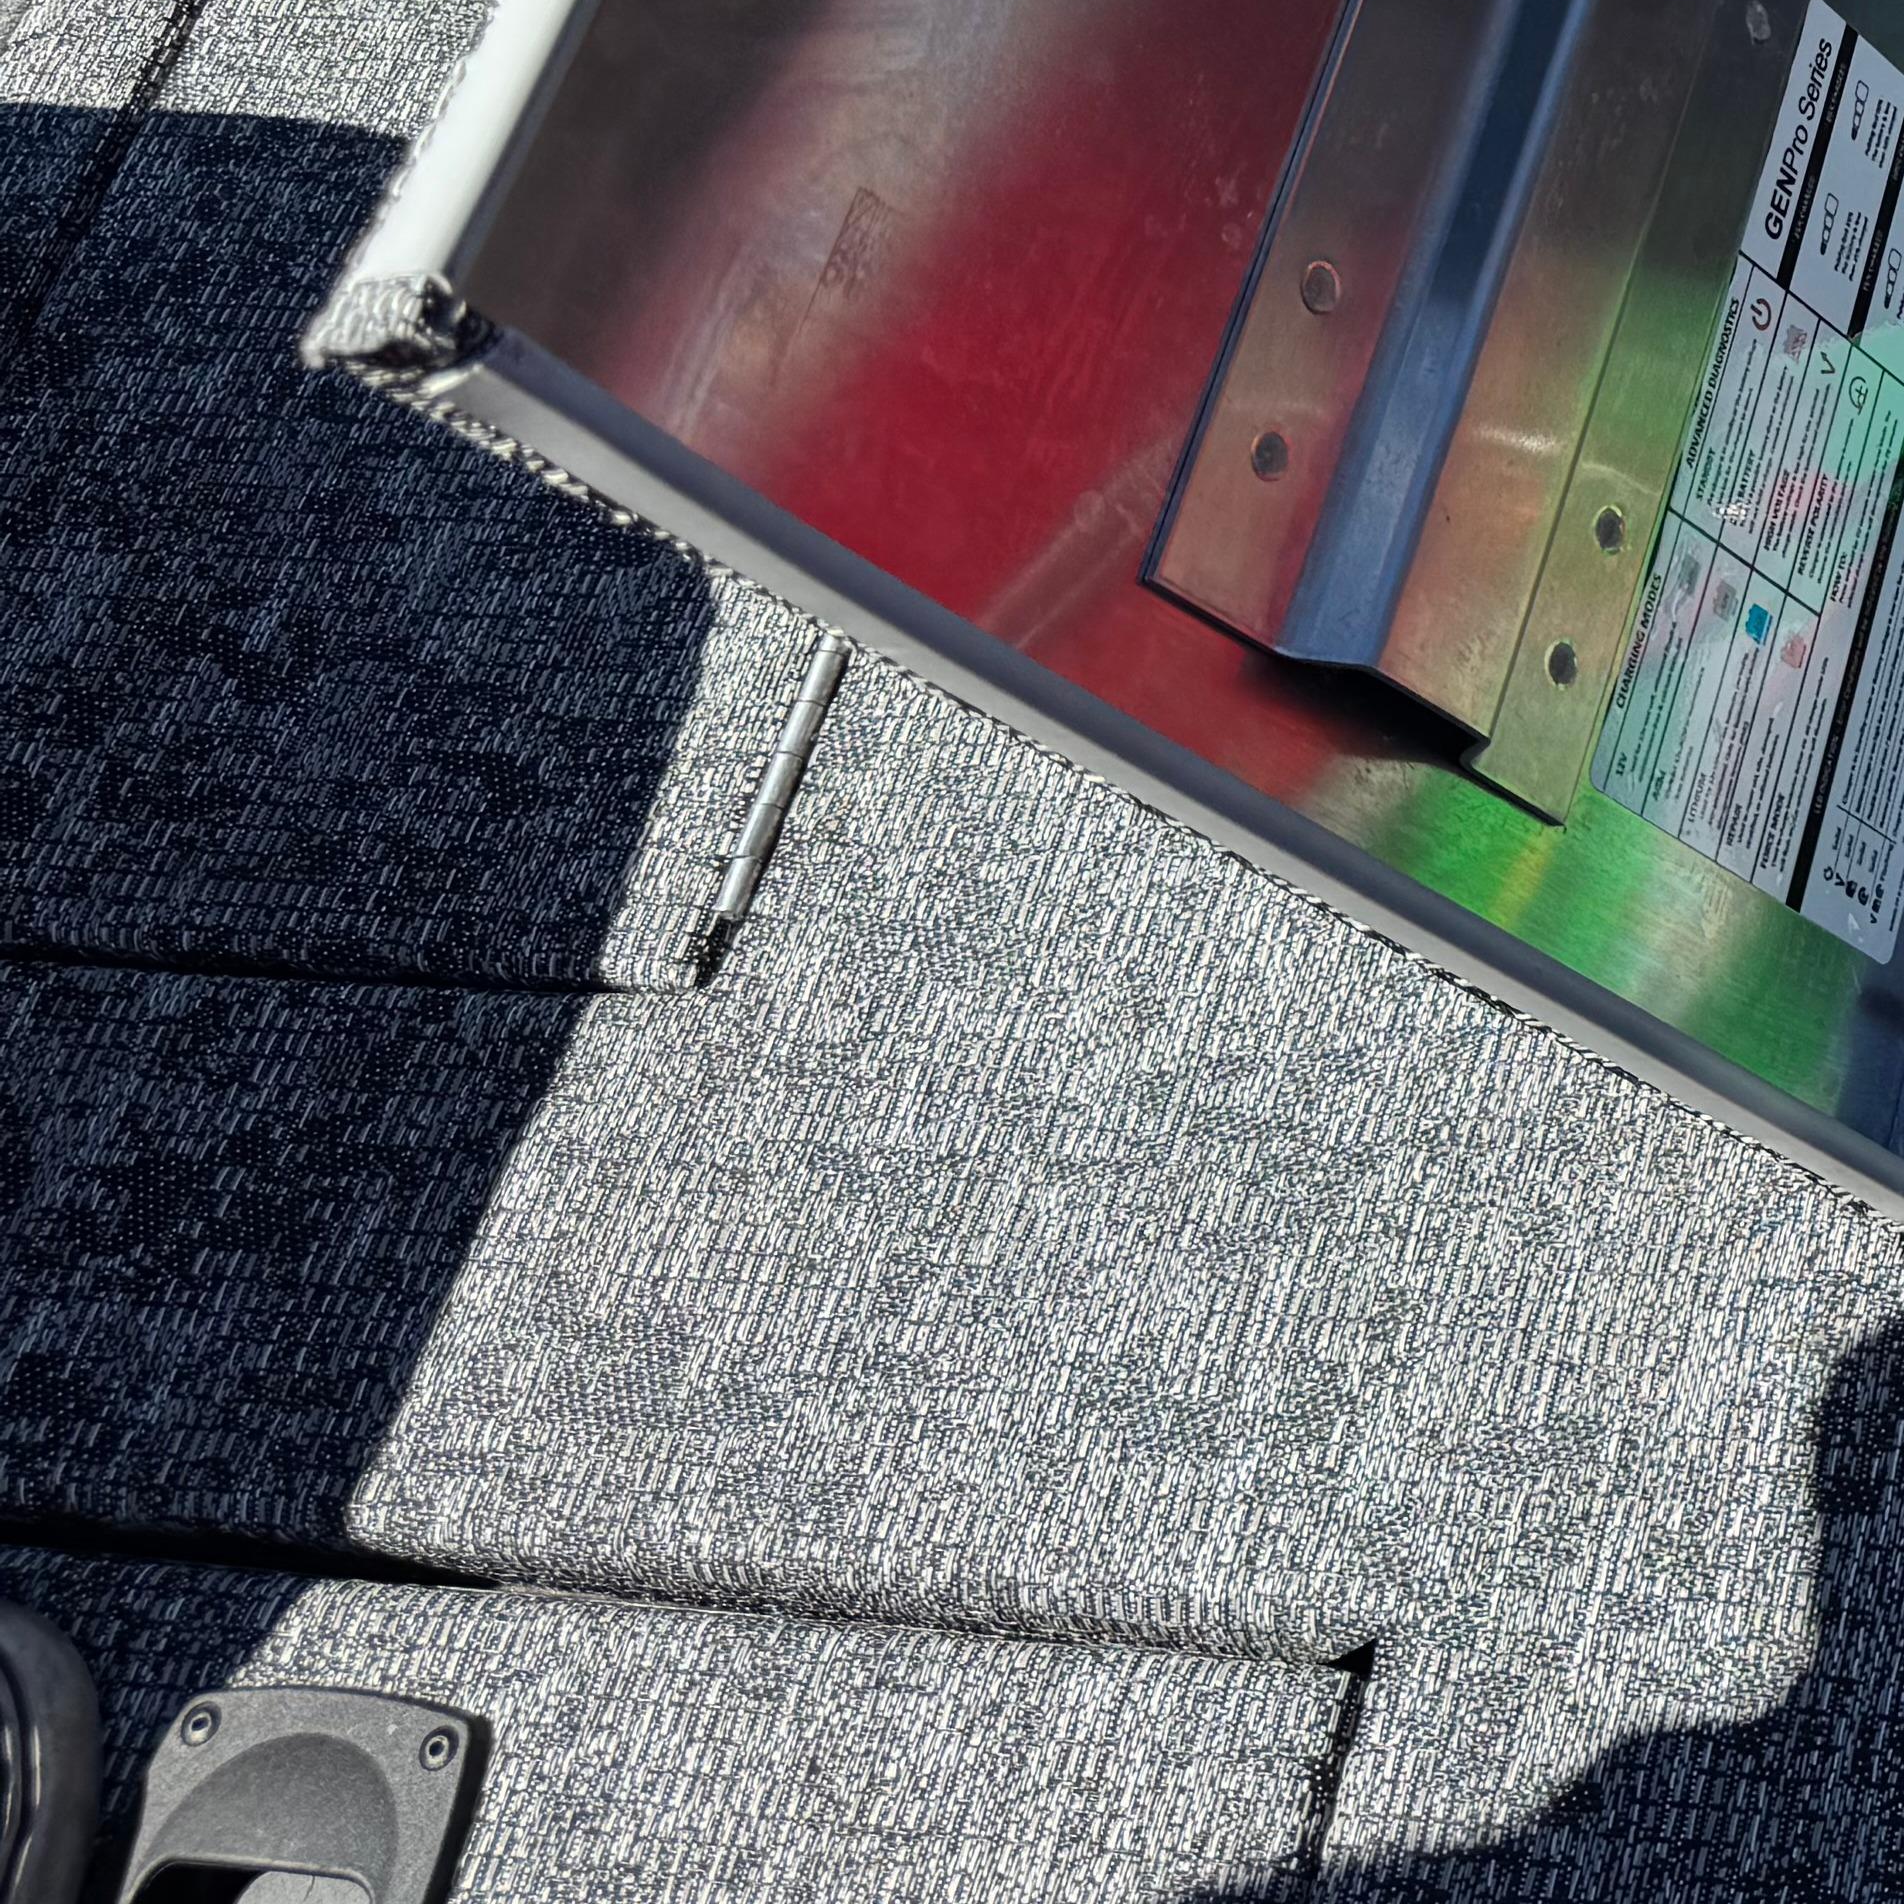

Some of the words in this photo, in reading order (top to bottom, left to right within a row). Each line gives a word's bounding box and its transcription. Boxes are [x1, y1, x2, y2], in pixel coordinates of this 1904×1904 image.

[1762, 117, 1810, 244] GENPro
[1795, 31, 1833, 124] Series
[1685, 387, 1714, 470] ADVANCED
[1707, 294, 1740, 390] DIAGNOSTICS
[1771, 467, 1791, 522] VOLTAGE
[1796, 526, 1815, 576] REVERSE
[1809, 471, 1829, 528] POLARITY
[1614, 627, 1646, 711] CHARGING
[1637, 569, 1663, 631] MODES
[1725, 801, 1743, 847] REPAIR
[1759, 829, 1776, 870] FORCE
[1769, 791, 1785, 831] MODE
